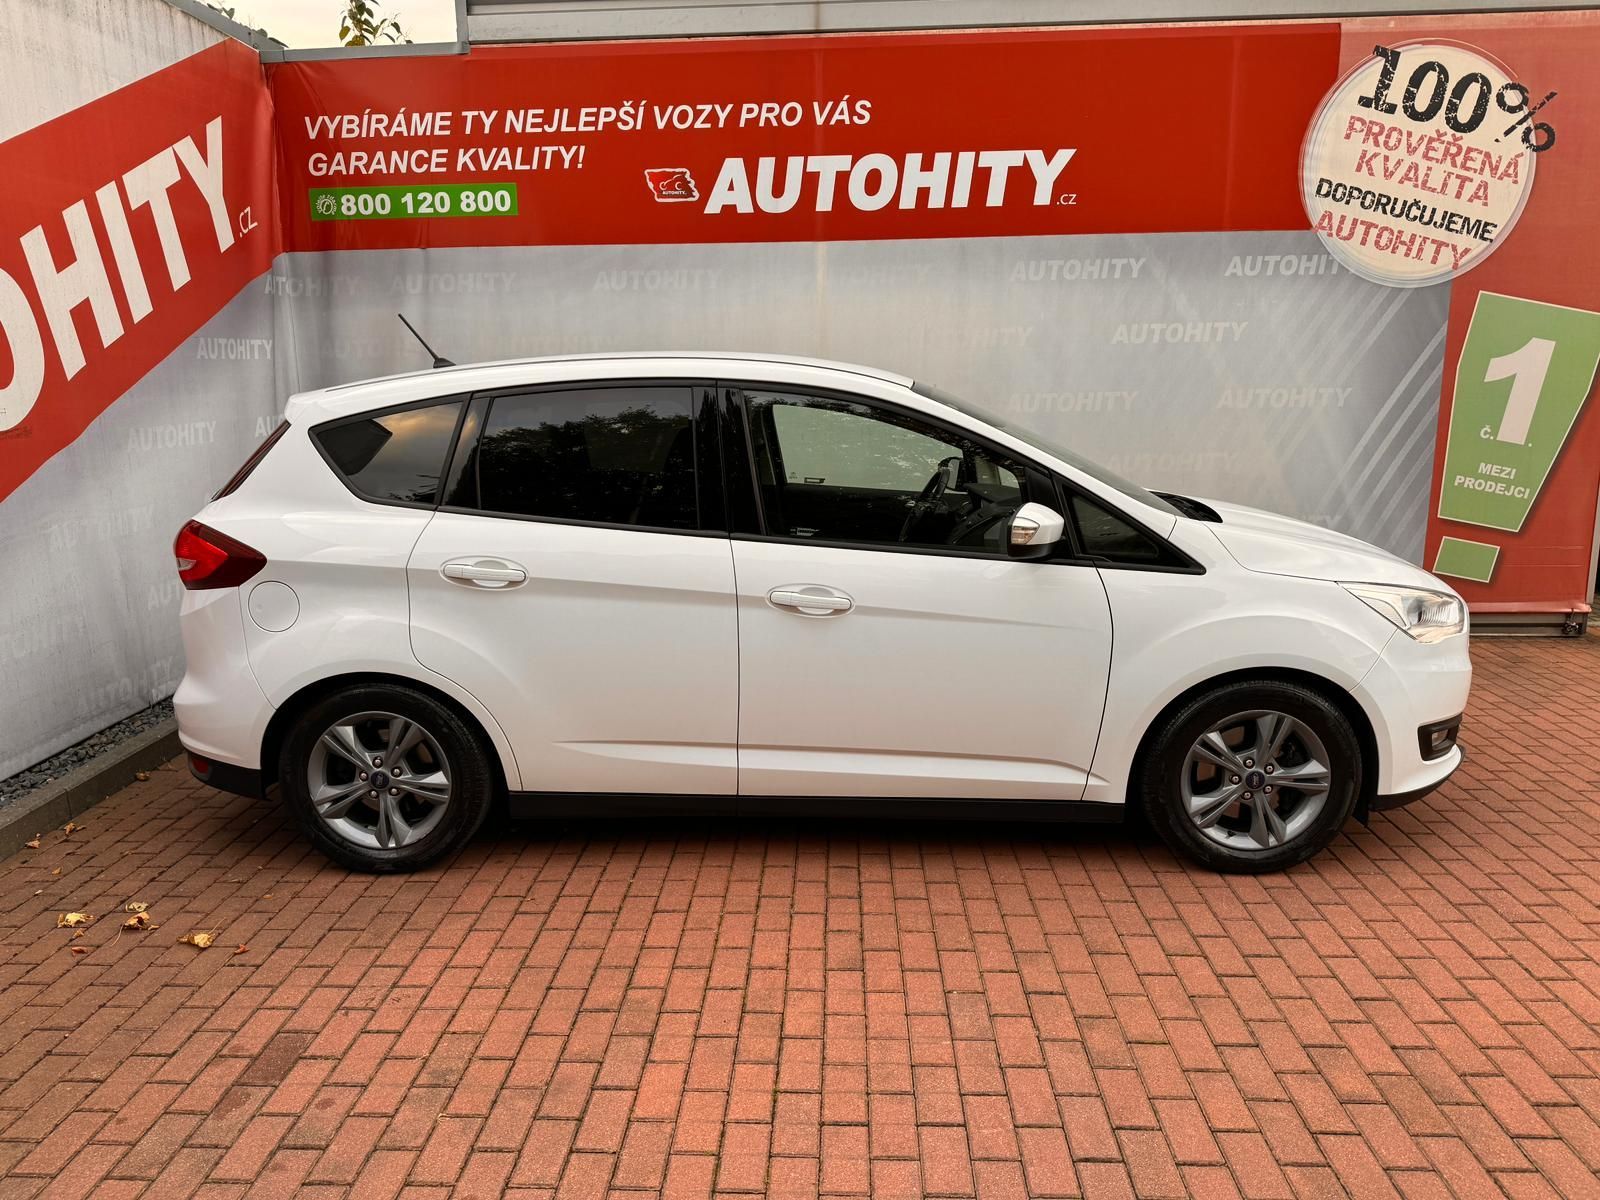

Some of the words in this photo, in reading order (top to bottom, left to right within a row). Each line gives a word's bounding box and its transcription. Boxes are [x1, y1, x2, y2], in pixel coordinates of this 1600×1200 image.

[1358, 45, 1558, 152] 100%
[304, 108, 452, 140] VYBÍRÁME
[461, 110, 498, 135] TY
[504, 100, 647, 134] NEJLEPŠÍ
[653, 103, 734, 130] VOZY
[739, 101, 803, 128] PRO
[812, 94, 872, 126] VÁS
[308, 148, 449, 177] GARANCE
[456, 145, 586, 172] KVALITY!
[1343, 115, 1525, 184] PROVĚŘENÁ
[703, 148, 1078, 214] AUTOHITY
[1354, 149, 1489, 207] KVALITA
[341, 193, 392, 216] 800
[401, 191, 451, 214] 120
[460, 190, 511, 212] 800
[1315, 177, 1498, 243] DOPORUČUJEME
[1312, 209, 1472, 270] AUTOHITY
[1010, 257, 1146, 282] AUTOHITY
[1111, 320, 1249, 345] AUTOHITY
[197, 337, 273, 361] AUTOHITY
[1216, 386, 1353, 411] AUTOHITY
[127, 420, 217, 451] AUTOHITY
[1478, 462, 1517, 480] MEZI
[1454, 475, 1530, 499] PRODEJCI
